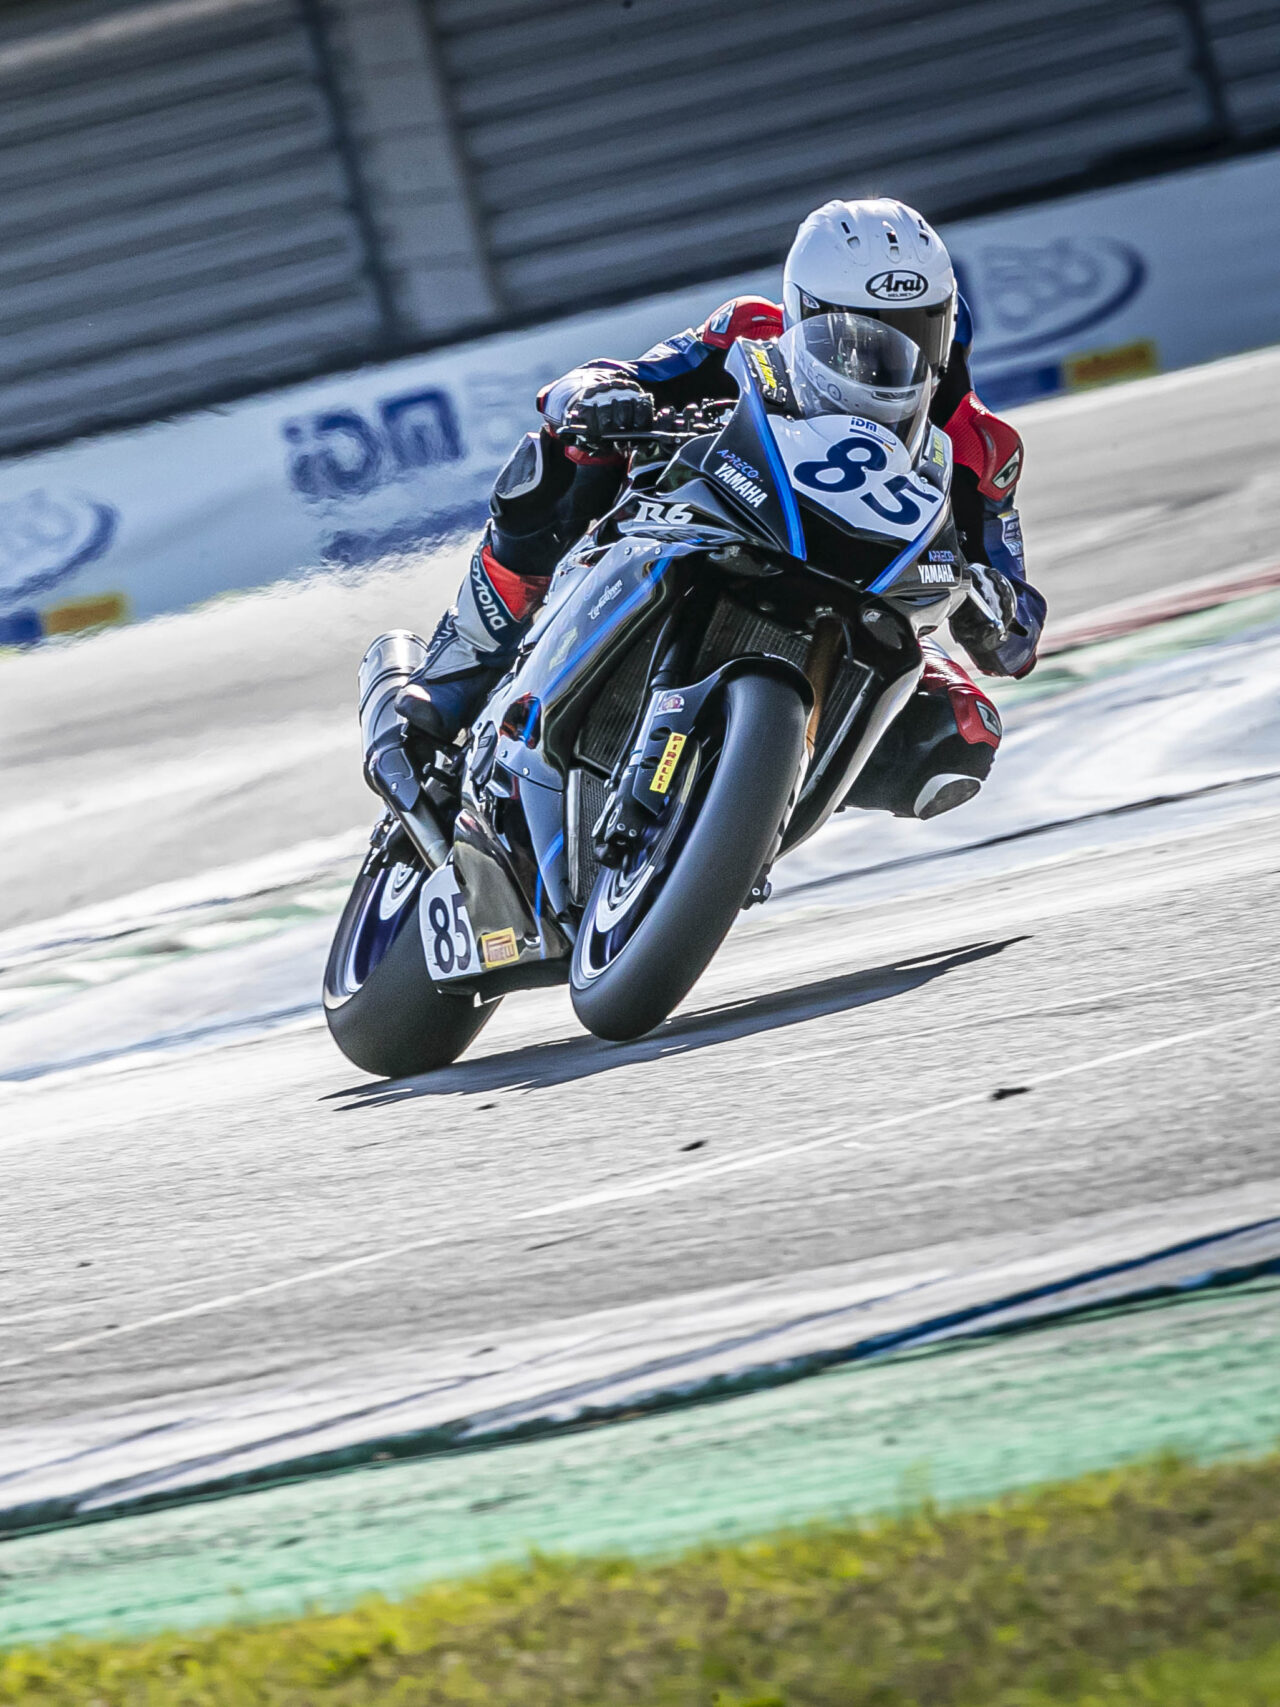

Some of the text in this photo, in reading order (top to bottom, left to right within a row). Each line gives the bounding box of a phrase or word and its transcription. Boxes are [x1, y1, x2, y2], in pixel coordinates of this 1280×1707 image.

[870, 272, 923, 293] Arai
[713, 462, 769, 509] YAMAHA
[793, 437, 939, 526] 85
[633, 500, 694, 526] R6
[917, 564, 956, 584] YAMAHA
[656, 735, 683, 790] PIRELLI
[429, 893, 471, 974] 85
